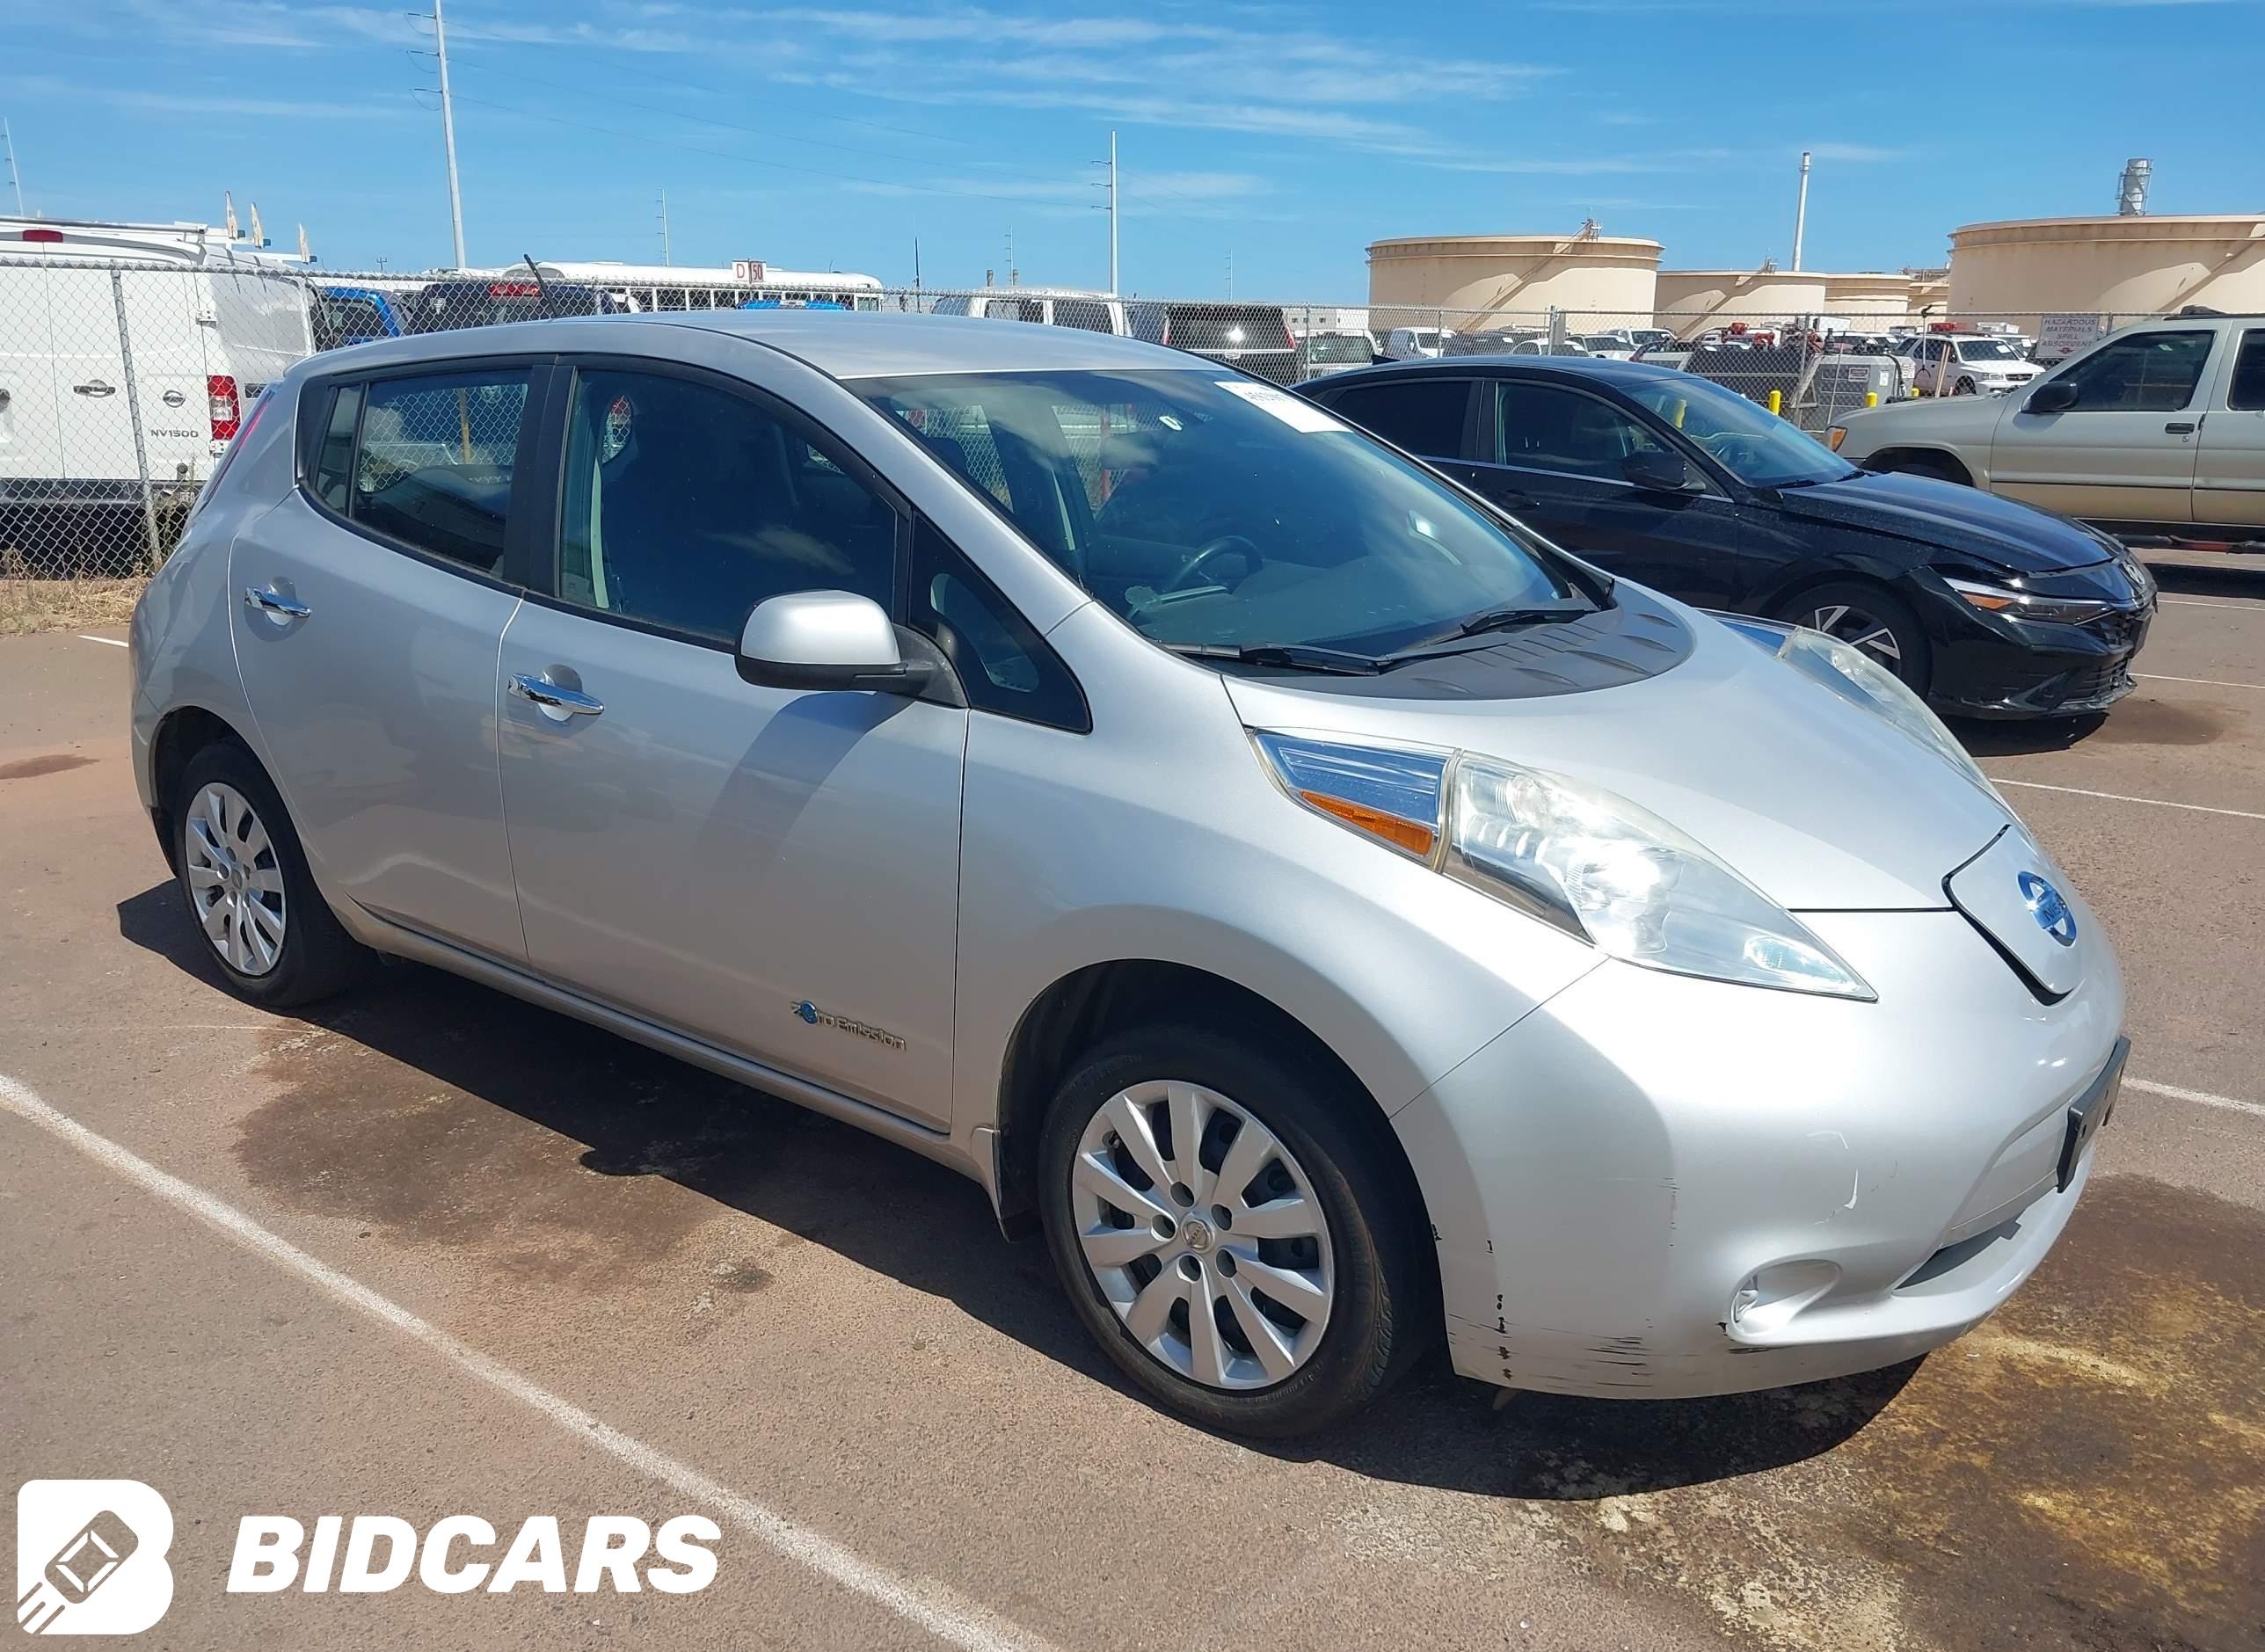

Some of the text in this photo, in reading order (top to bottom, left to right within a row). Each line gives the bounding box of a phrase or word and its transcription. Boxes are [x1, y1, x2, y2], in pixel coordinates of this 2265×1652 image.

[753, 264, 763, 280] 50
[150, 429, 199, 438] NV1500
[836, 1015, 907, 1051] Emission
